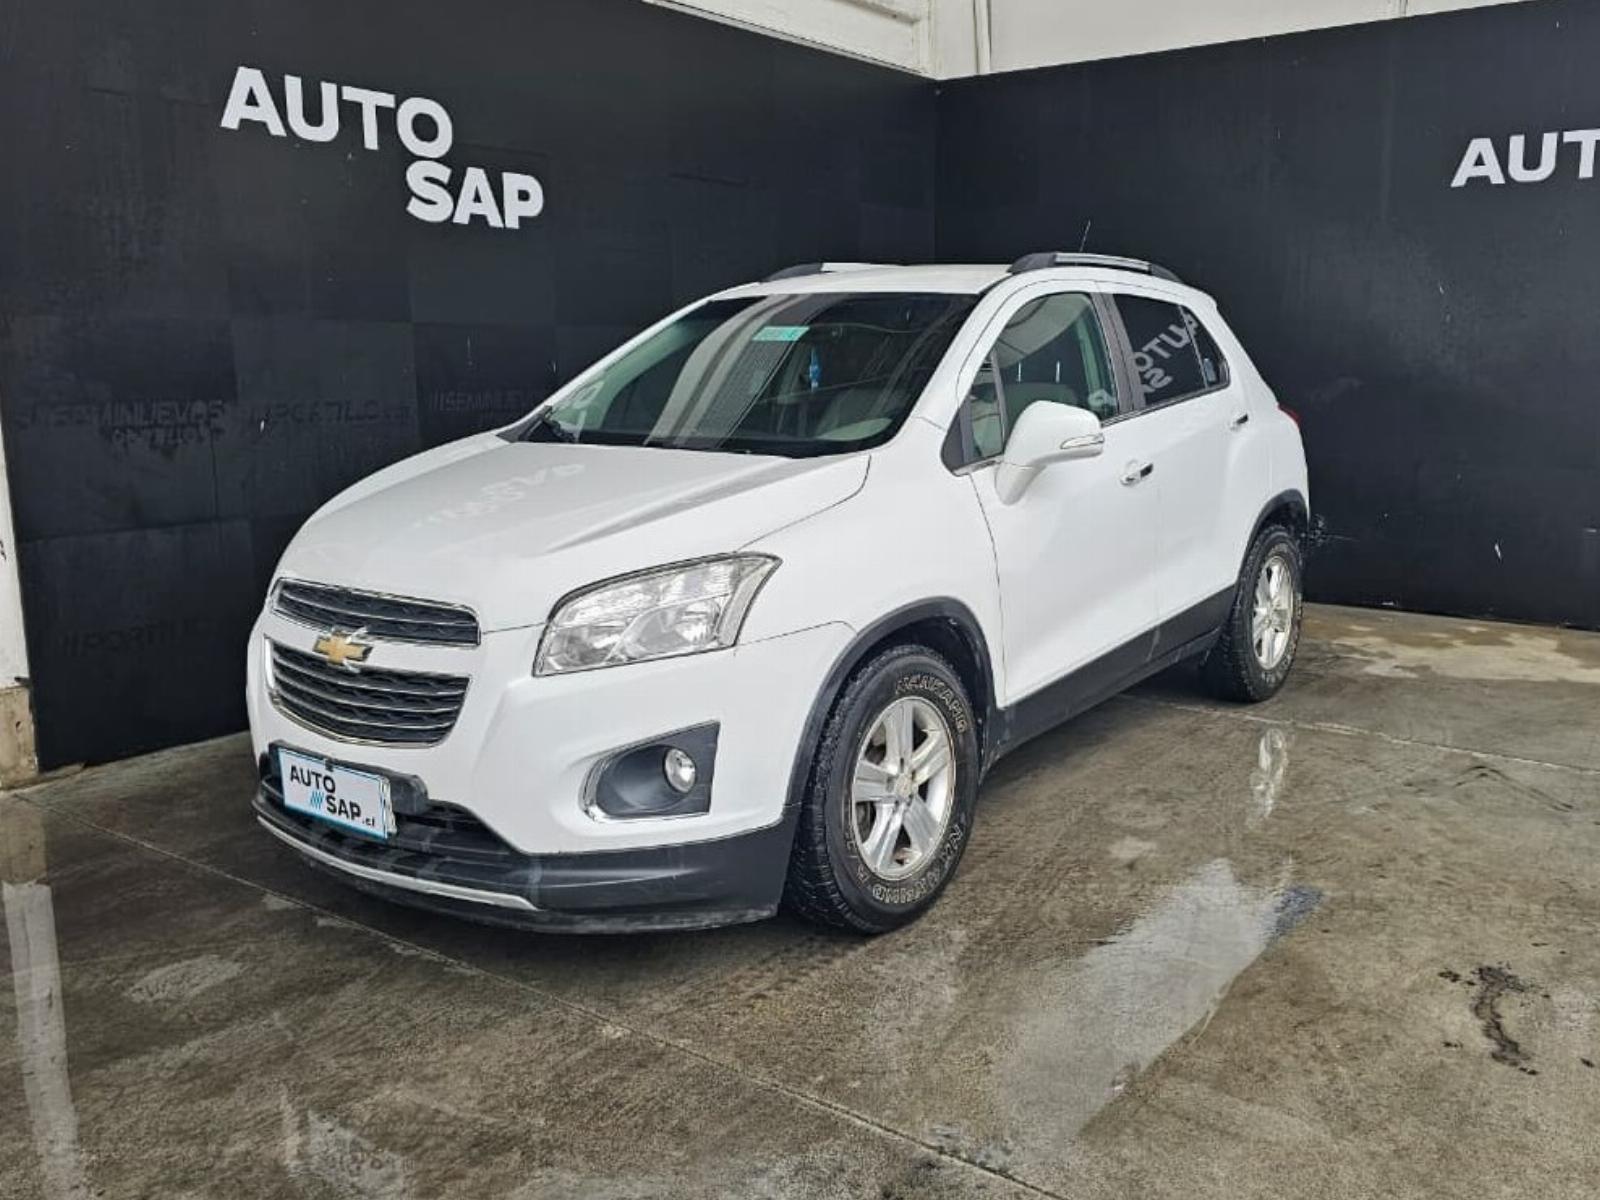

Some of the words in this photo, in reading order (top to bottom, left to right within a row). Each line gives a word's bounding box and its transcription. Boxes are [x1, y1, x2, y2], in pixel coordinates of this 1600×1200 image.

[220, 66, 452, 159] AUTO
[1450, 128, 1600, 188] AUT
[405, 160, 544, 230] SAP
[290, 765, 336, 793] AUTO
